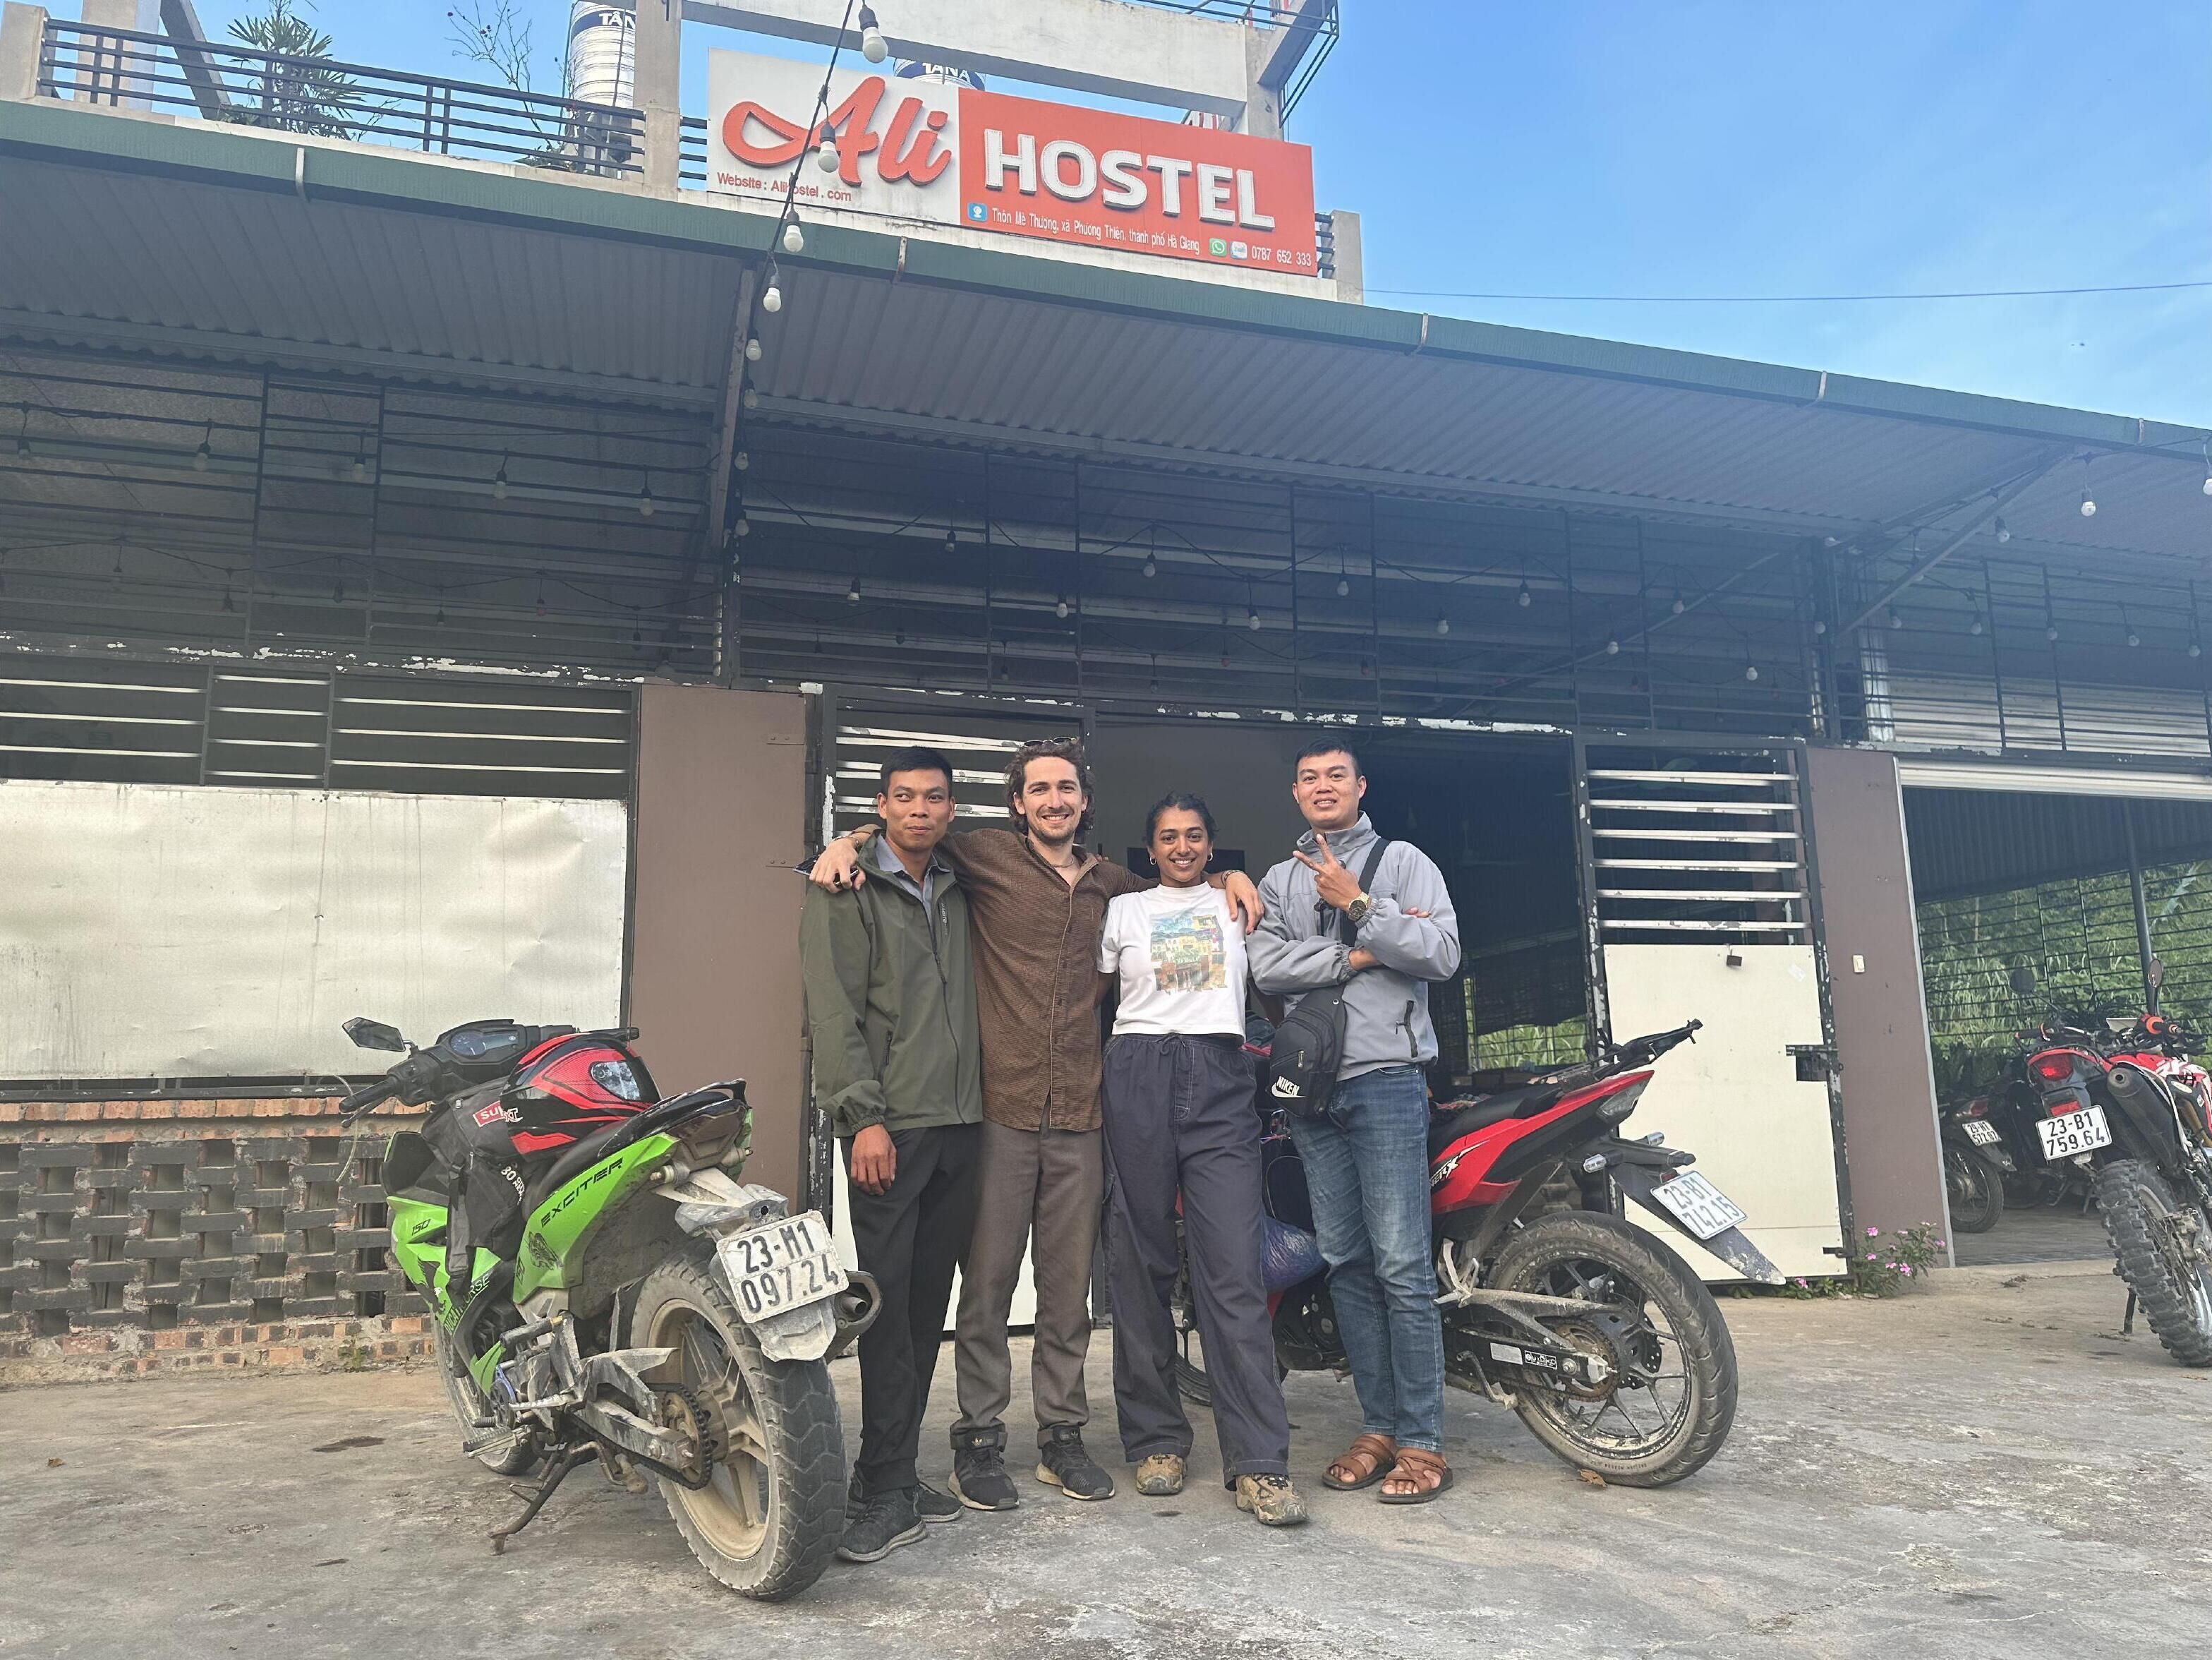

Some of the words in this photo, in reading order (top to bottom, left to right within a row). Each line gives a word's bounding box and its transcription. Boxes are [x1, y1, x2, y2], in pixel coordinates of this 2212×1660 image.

[723, 76, 952, 186] Ali
[984, 128, 1275, 231] HOSTEL
[992, 208, 1011, 224] Thôn
[1062, 219, 1070, 232] xã
[1152, 231, 1165, 248] phố
[1168, 234, 1177, 248] Hà
[1180, 236, 1199, 255] Giang
[1252, 246, 1271, 260] 0787
[1277, 249, 1292, 264] 652
[1296, 252, 1311, 266] 333
[2046, 1127, 2105, 1156] 759.64
[2048, 1112, 2093, 1137] 23-B1
[541, 1157, 623, 1228] EXCITER
[1664, 1177, 1712, 1209] 23-B1
[412, 1219, 431, 1236] 150
[1682, 1196, 1739, 1234] 742.15
[737, 1221, 814, 1273] 23-M1
[741, 1253, 838, 1313] 097.24
